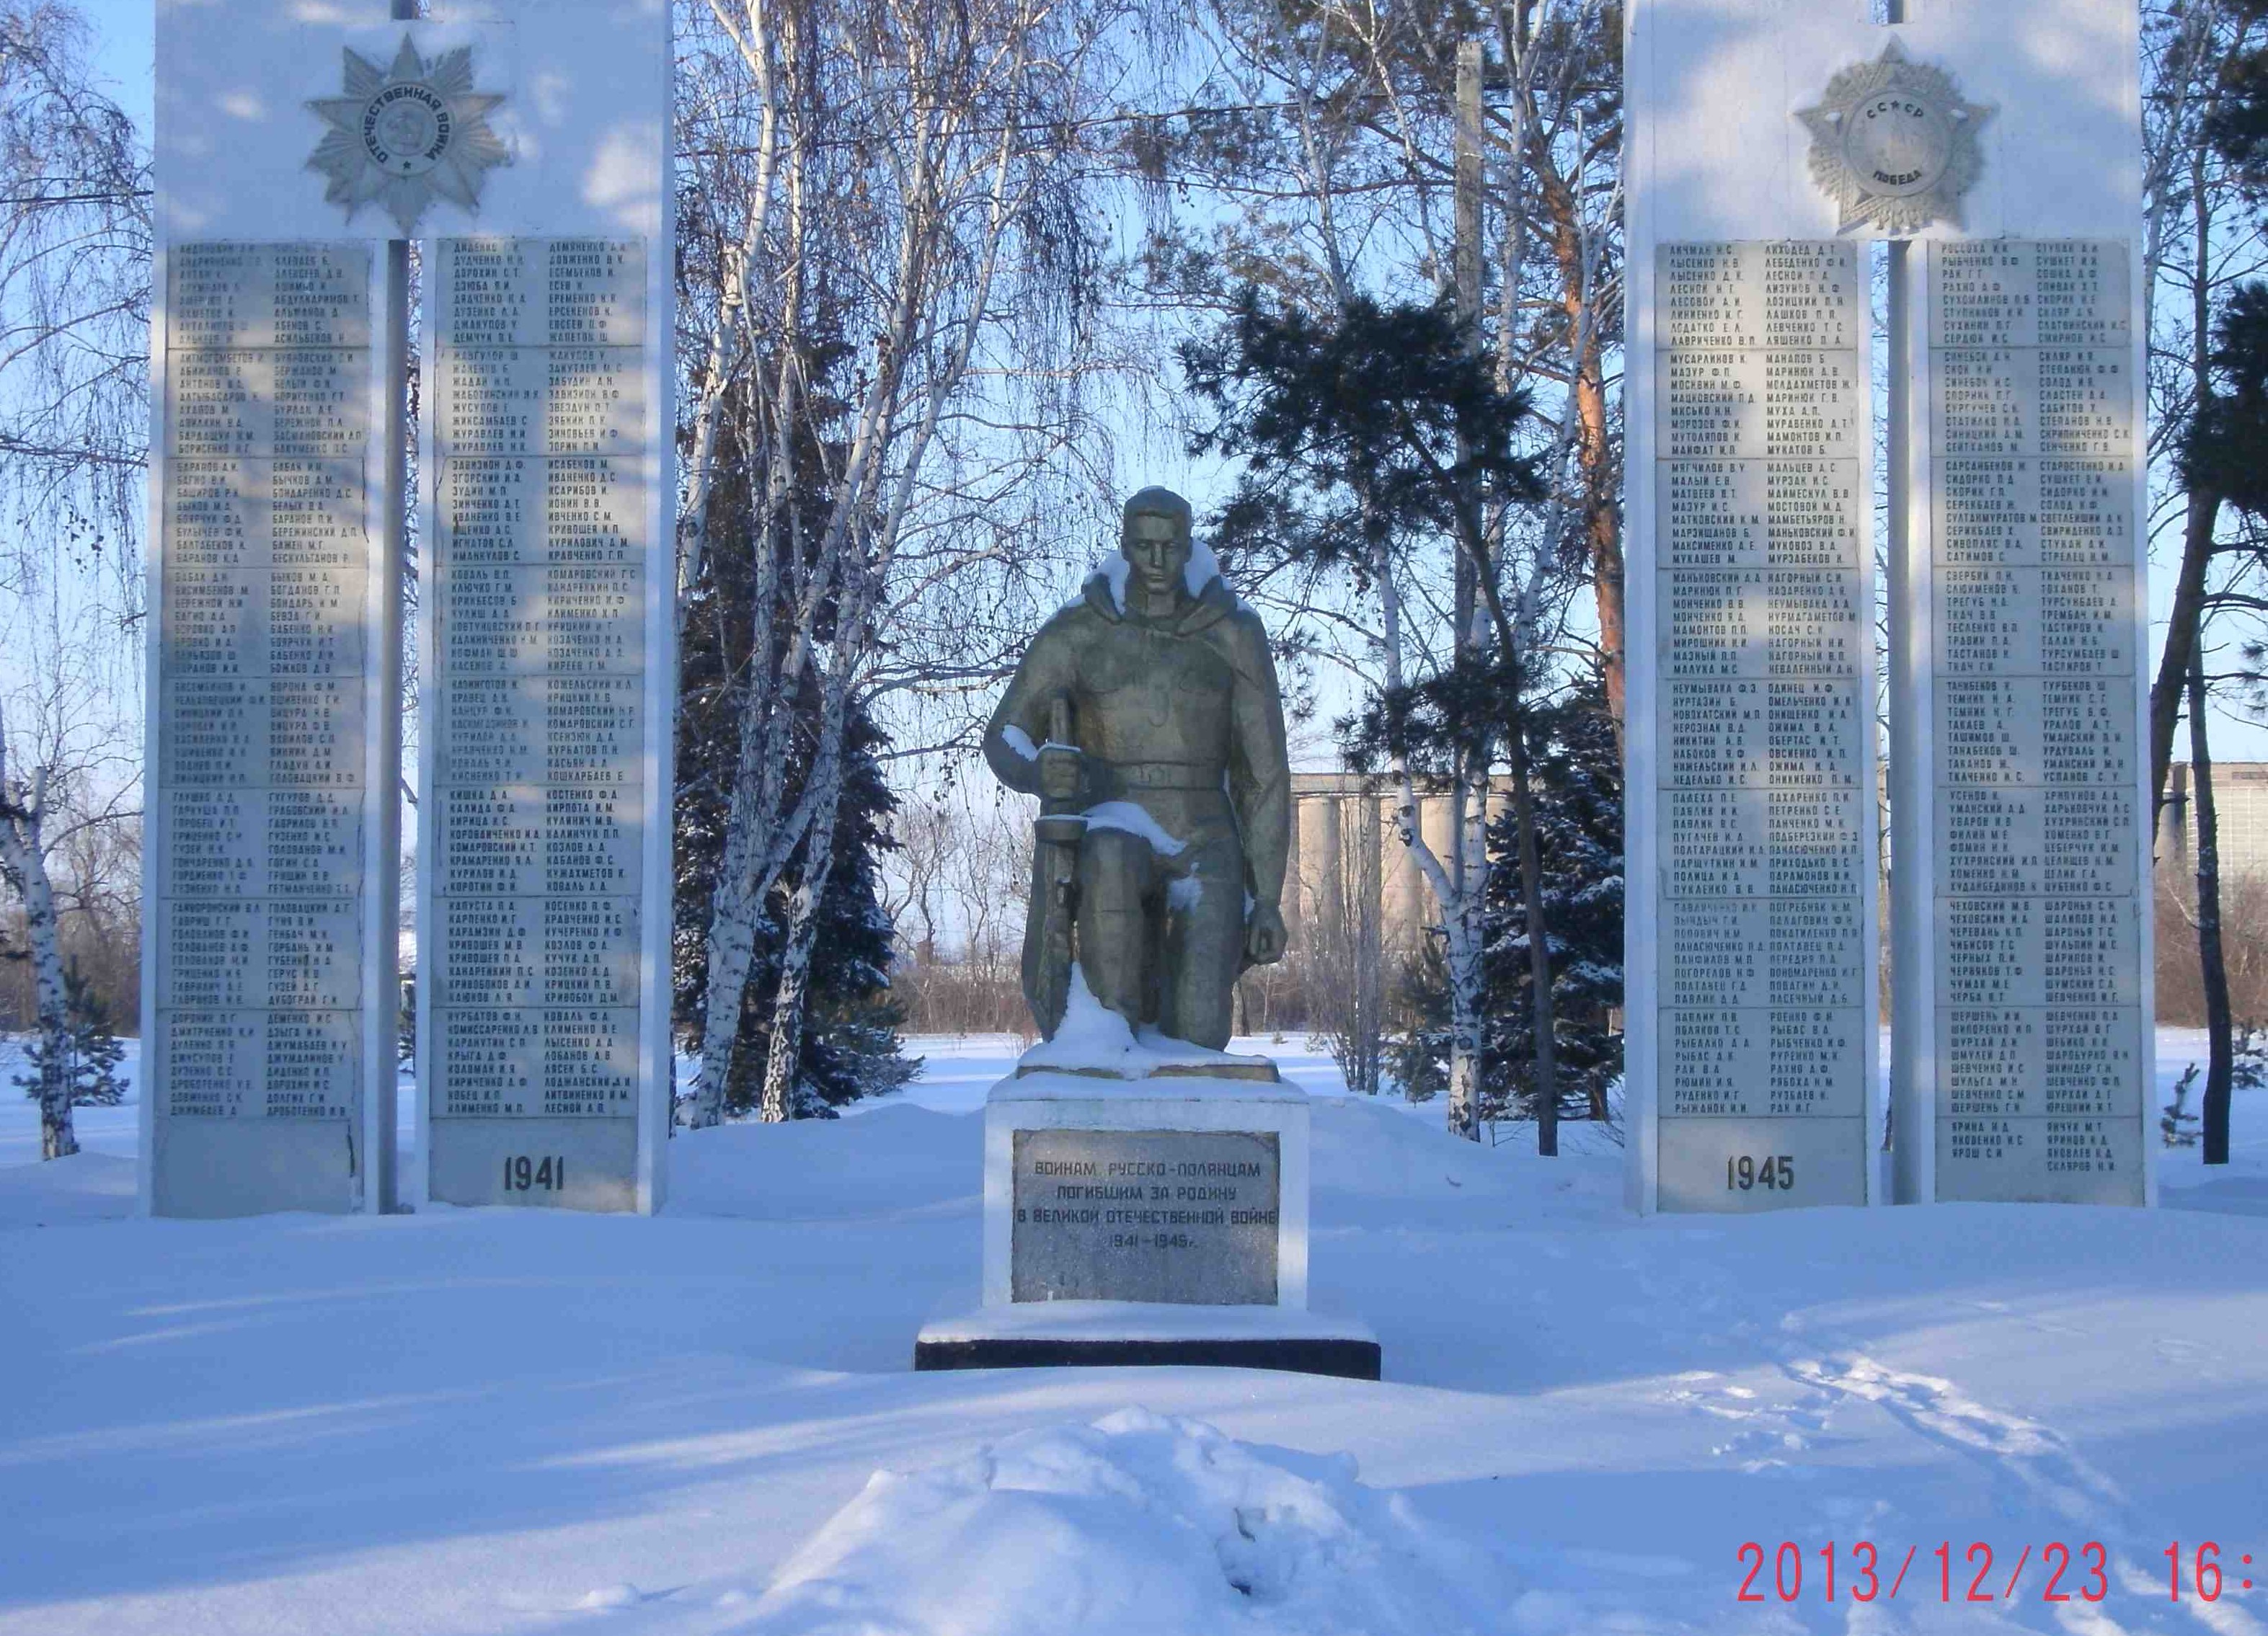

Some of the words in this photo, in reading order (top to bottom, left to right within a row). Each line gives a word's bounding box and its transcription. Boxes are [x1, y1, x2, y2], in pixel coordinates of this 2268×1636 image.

[365, 86, 442, 163] ОТЕЧЕСТВЕННАЯ
[1873, 169, 1923, 186] ПОБЕДА
[505, 1156, 564, 1191] 1941
[1035, 1161, 1097, 1175] ВОИНАМ
[1727, 1155, 1795, 1191] 1945
[1057, 1186, 1143, 1201] ПОГИБШИМ
[1150, 1186, 1170, 1200] ЗА
[1177, 1187, 1237, 1201] РОДИНУ
[1018, 1209, 1027, 1224] В
[1033, 1206, 1099, 1224] ВЕЛИКОЙ
[1105, 1206, 1224, 1224] ОТЕЧЕСТВЕННОЙ
[1231, 1207, 1277, 1225] ВОЙНЕ
